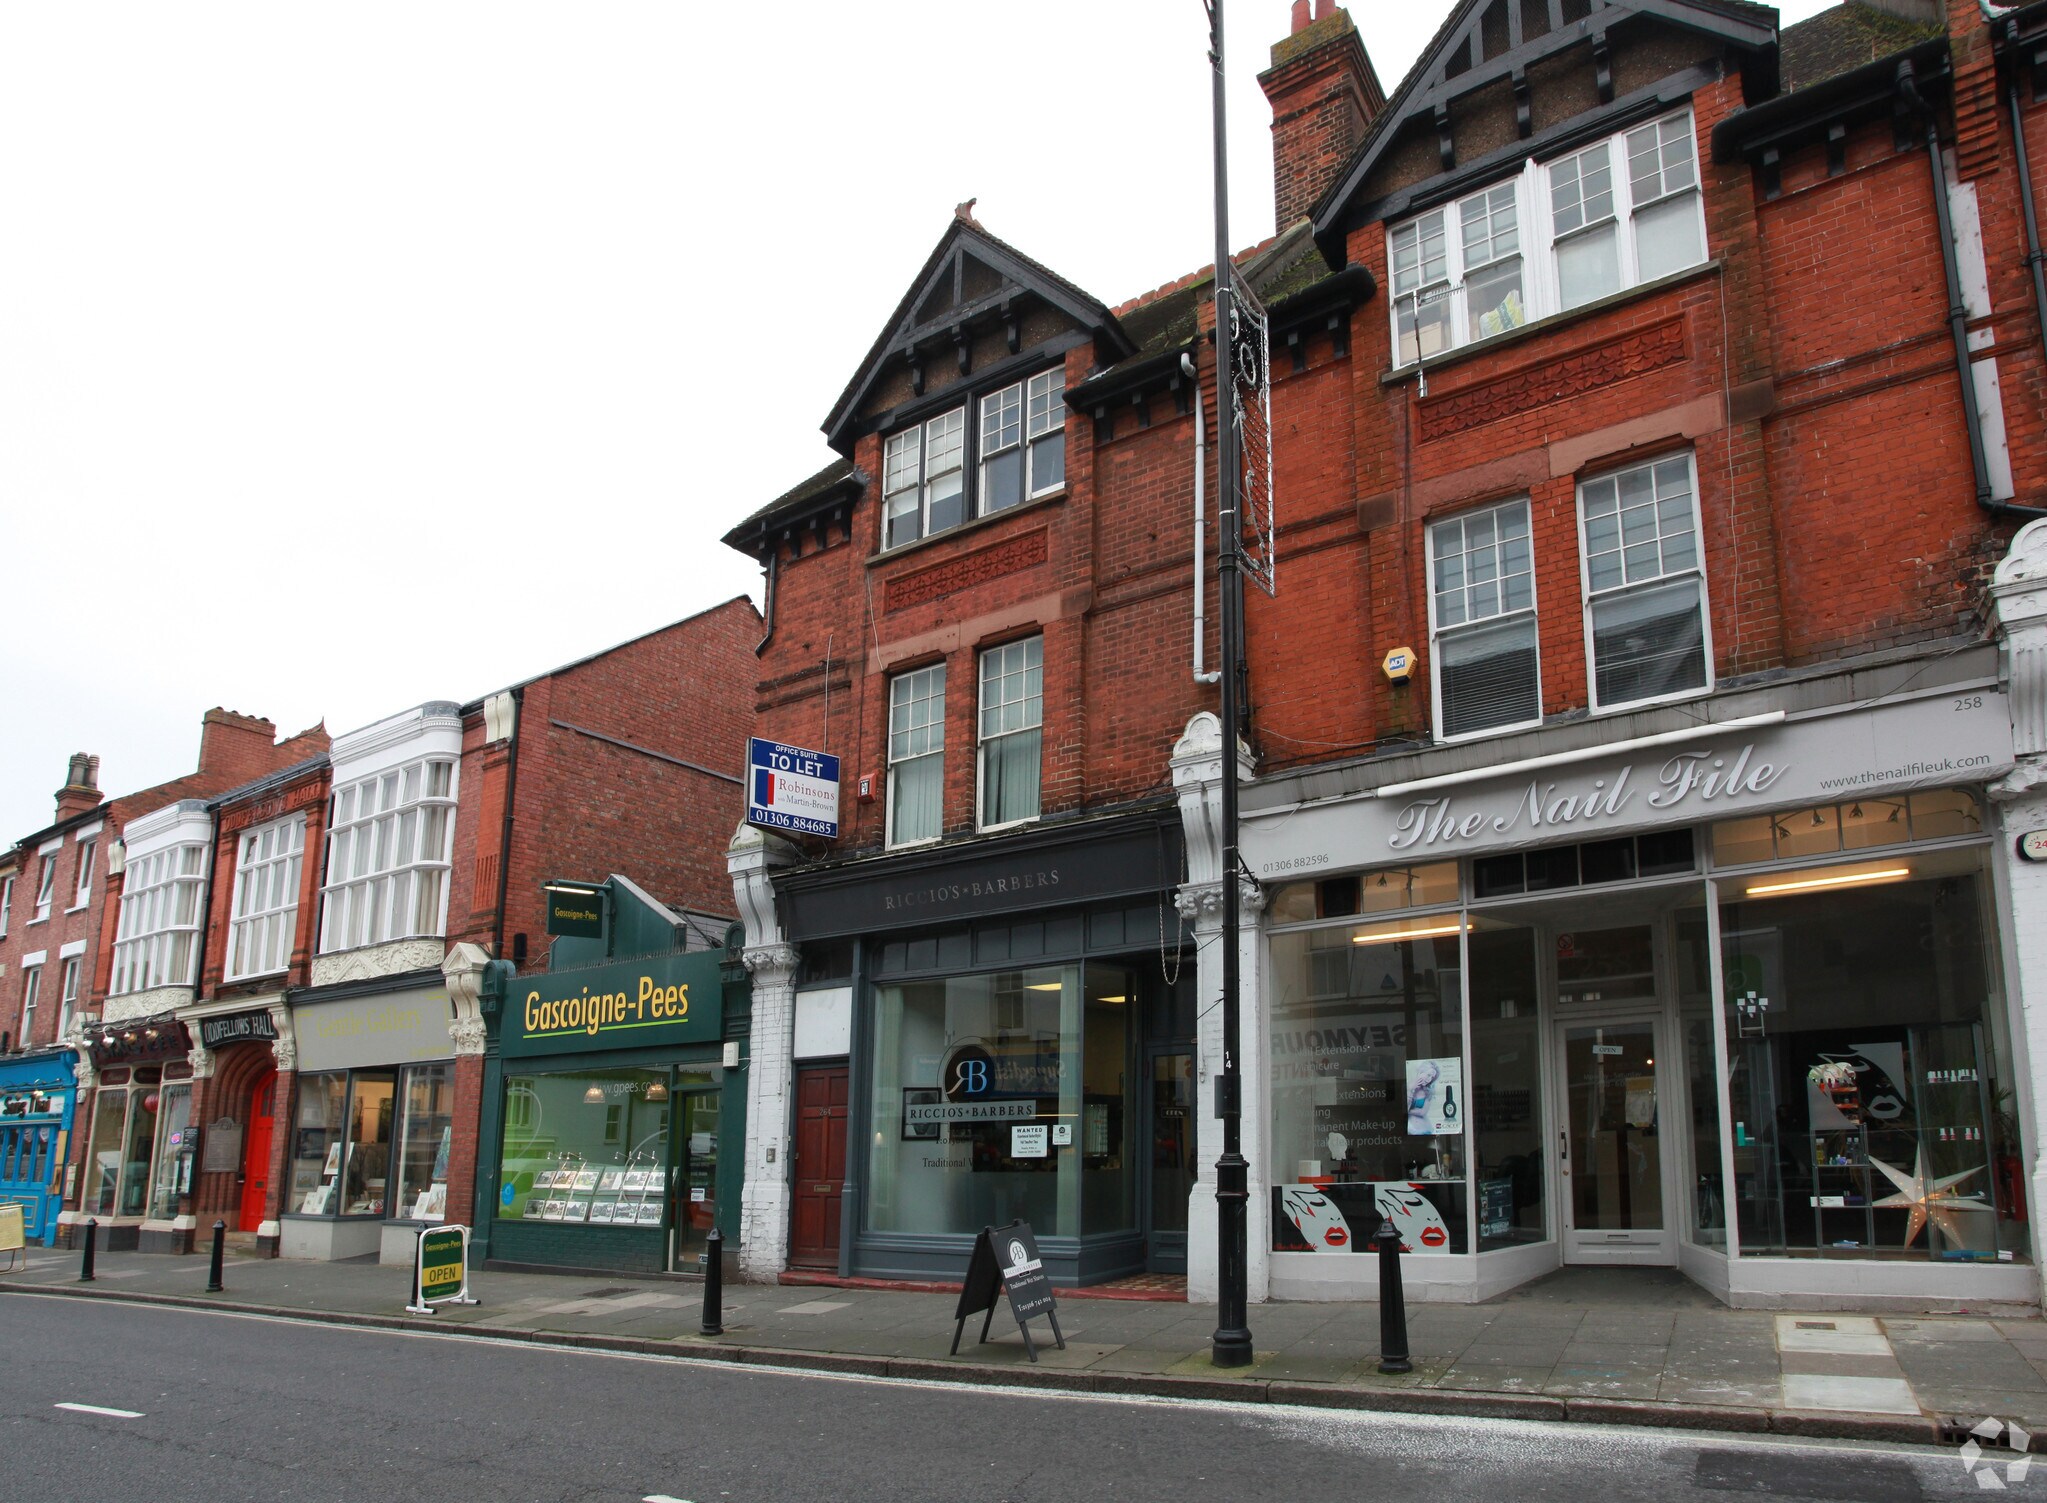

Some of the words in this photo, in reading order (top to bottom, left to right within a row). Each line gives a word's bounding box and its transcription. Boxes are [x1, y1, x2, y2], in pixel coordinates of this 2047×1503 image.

[1390, 657, 1405, 668] ADT
[1954, 696, 1982, 712] 258
[775, 745, 799, 756] OFFICE
[800, 750, 818, 760] SUITE
[769, 752, 790, 772] TO
[796, 758, 823, 777] LET
[1820, 754, 1990, 790] www.thenailfileuk.com
[779, 778, 835, 801] Robinsons
[1388, 796, 1495, 849] The
[1493, 765, 1635, 831] Nail
[1647, 743, 1790, 809] File
[786, 794, 834, 812] Martin-Brown
[756, 809, 789, 826] 01306
[793, 817, 831, 834] 884685
[1263, 859, 1292, 873] 01306
[1294, 853, 1329, 868] 882596
[971, 869, 1060, 897] BARBERS
[554, 907, 598, 921] Gascoigne-Pees
[525, 976, 689, 1036] Gascoigne-Pees
[204, 1017, 250, 1043] ODDFELLOWS
[252, 1014, 274, 1036] HALL
[1315, 1044, 1368, 1056] Extensions
[819, 1108, 832, 1116] 264
[910, 1107, 964, 1119] RICCIO'S
[972, 1105, 1032, 1117] BARBERS
[1351, 1120, 1396, 1131] Make-up
[1357, 1135, 1402, 1148] products
[922, 1157, 967, 1168] Traditional
[429, 1266, 456, 1282] OPEN
